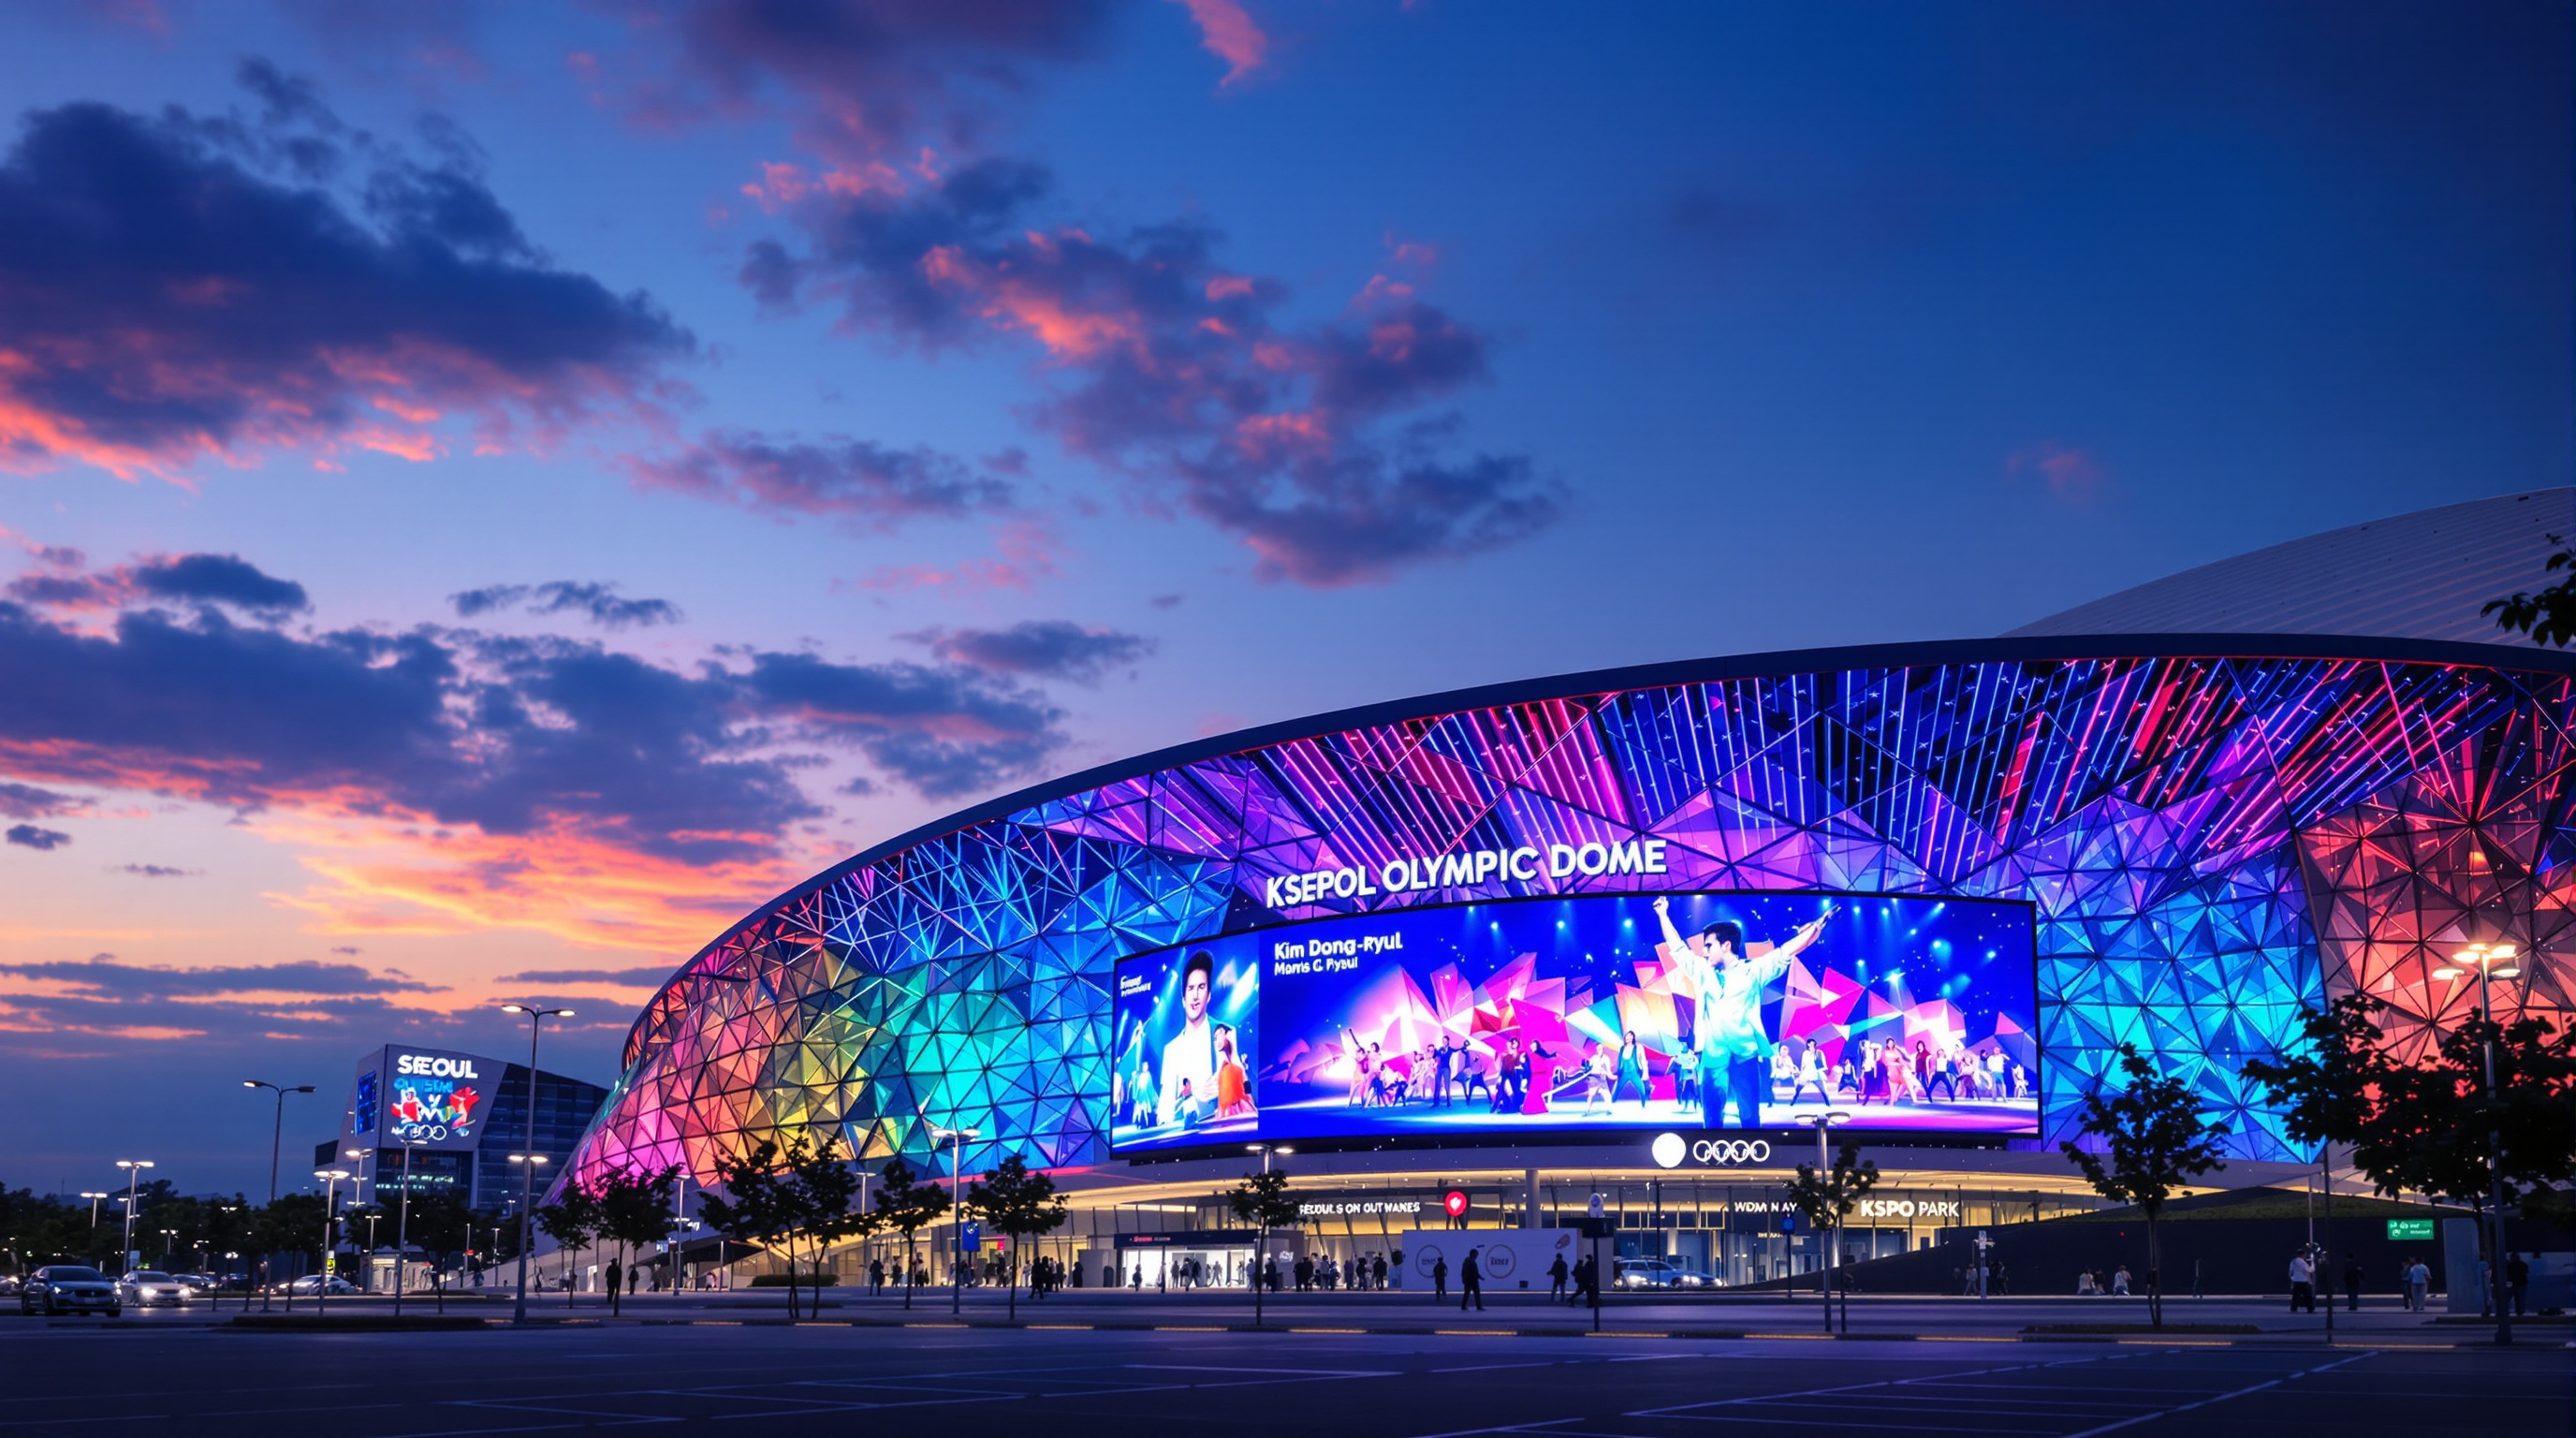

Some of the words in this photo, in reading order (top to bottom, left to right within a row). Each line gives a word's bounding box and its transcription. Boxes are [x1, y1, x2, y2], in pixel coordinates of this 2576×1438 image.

[1266, 864, 1376, 909] KSEPOL
[1382, 846, 1539, 893] OLYMPIC
[1549, 840, 1667, 879] DOME
[1274, 942, 1305, 961] Kim
[1309, 932, 1403, 957] Dong-Ryul
[1860, 1199, 1915, 1217] KSPO
[1918, 1200, 1960, 1217] PARK
